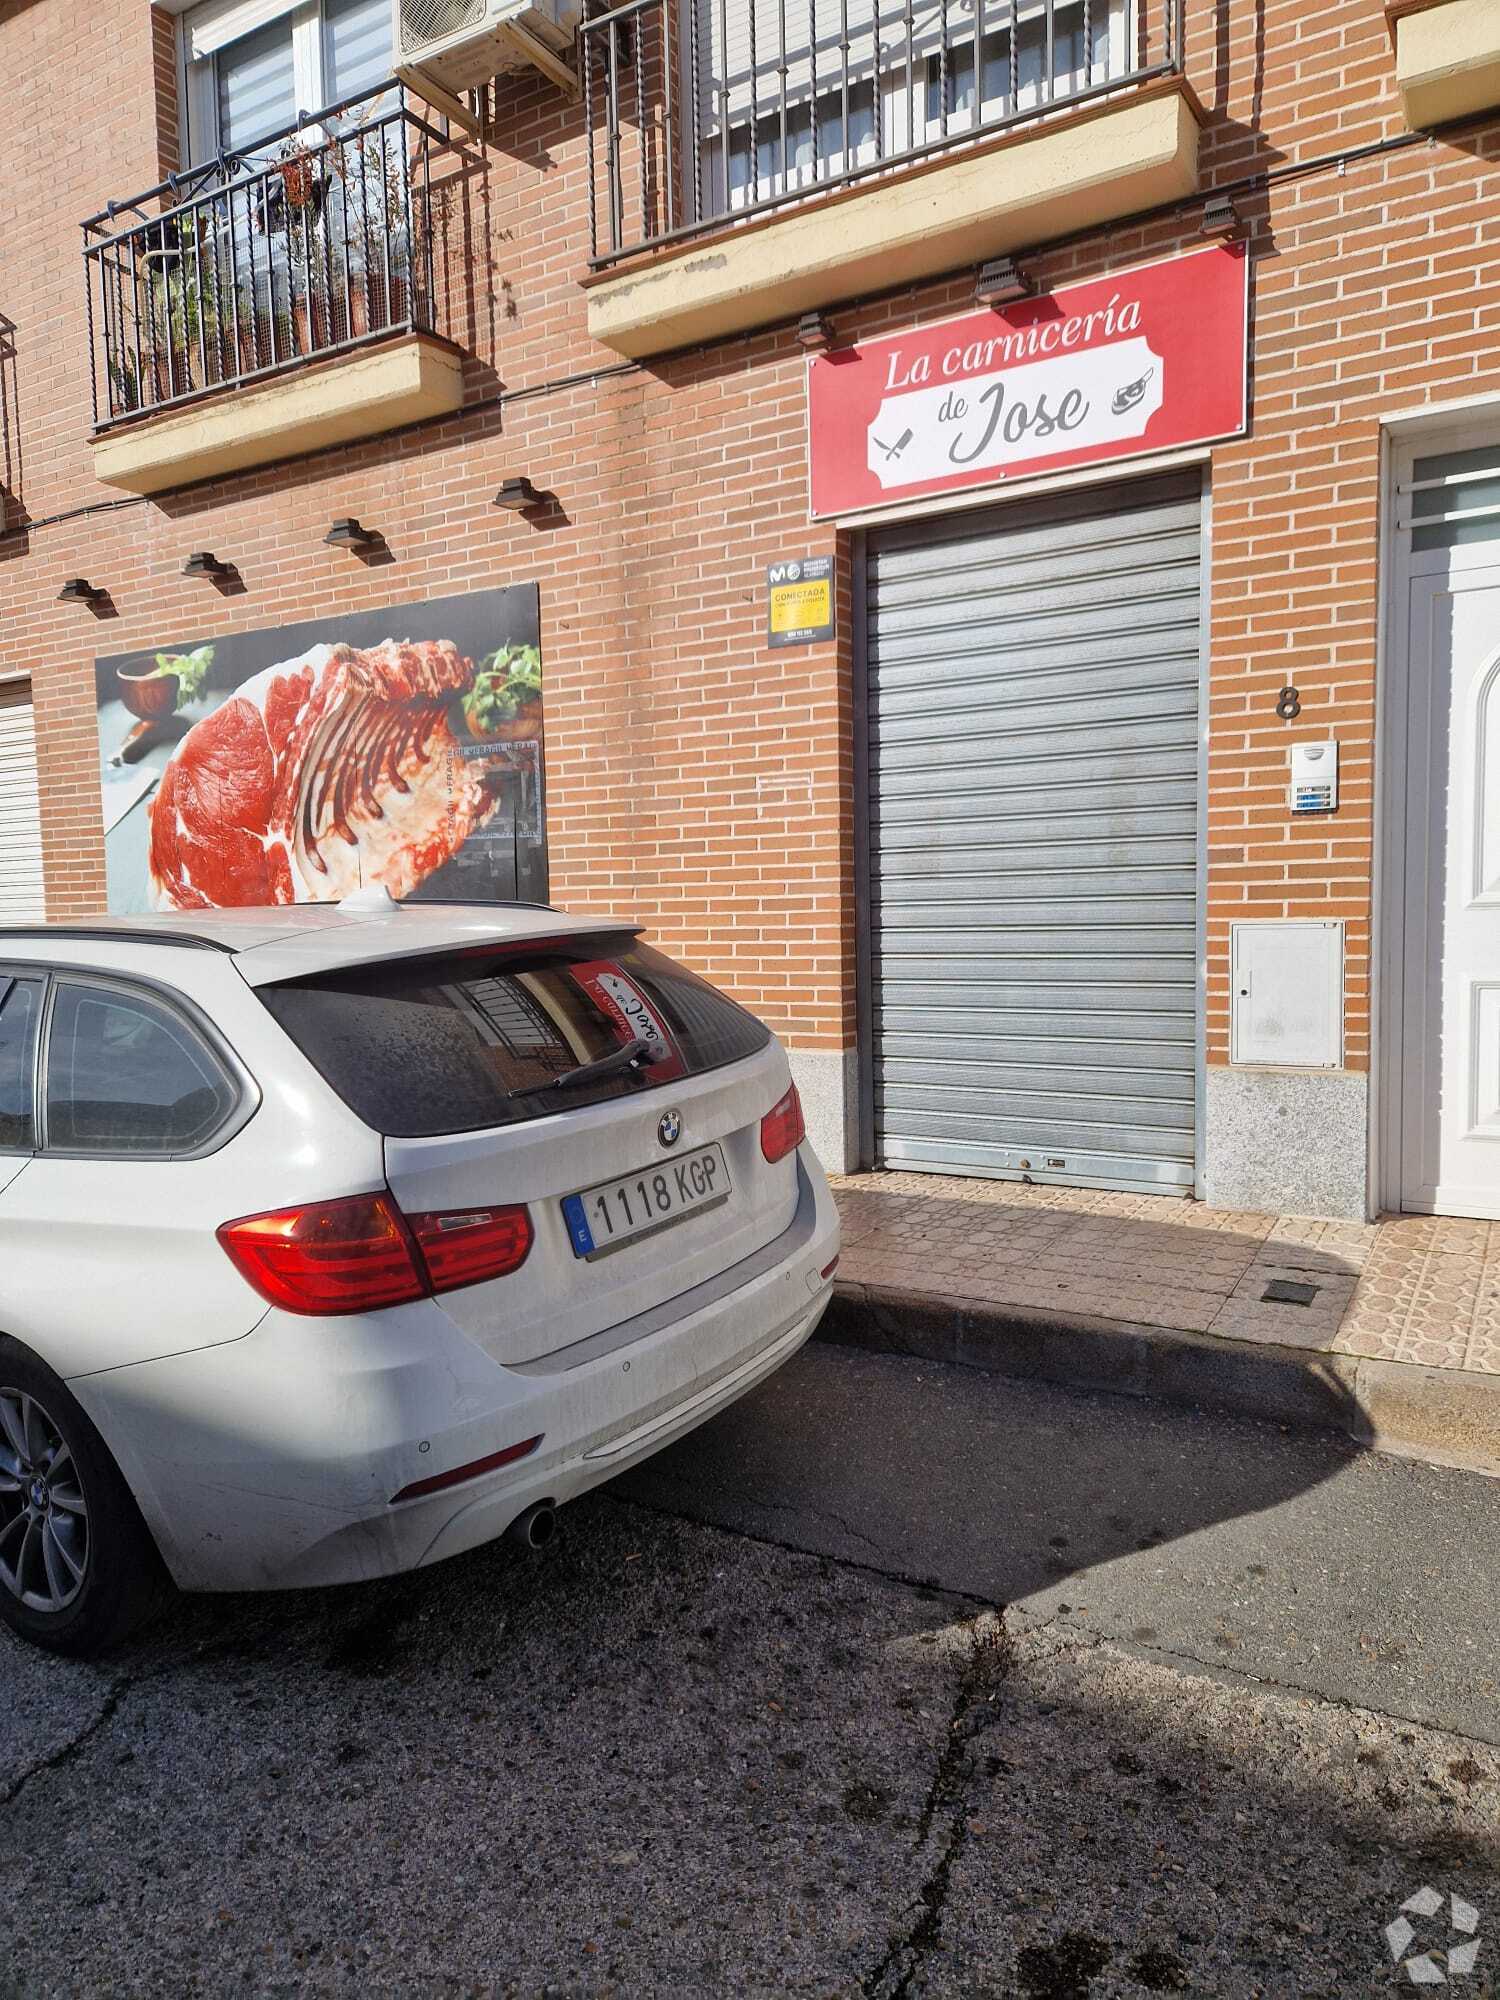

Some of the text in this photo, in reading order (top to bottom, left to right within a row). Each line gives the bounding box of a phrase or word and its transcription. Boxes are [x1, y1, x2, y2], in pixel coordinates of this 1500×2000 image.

[884, 293, 1142, 391] La carnicería
[937, 381, 1090, 464] de Jose
[1276, 686, 1301, 719] 8
[597, 1155, 716, 1233] 1118 KGP
